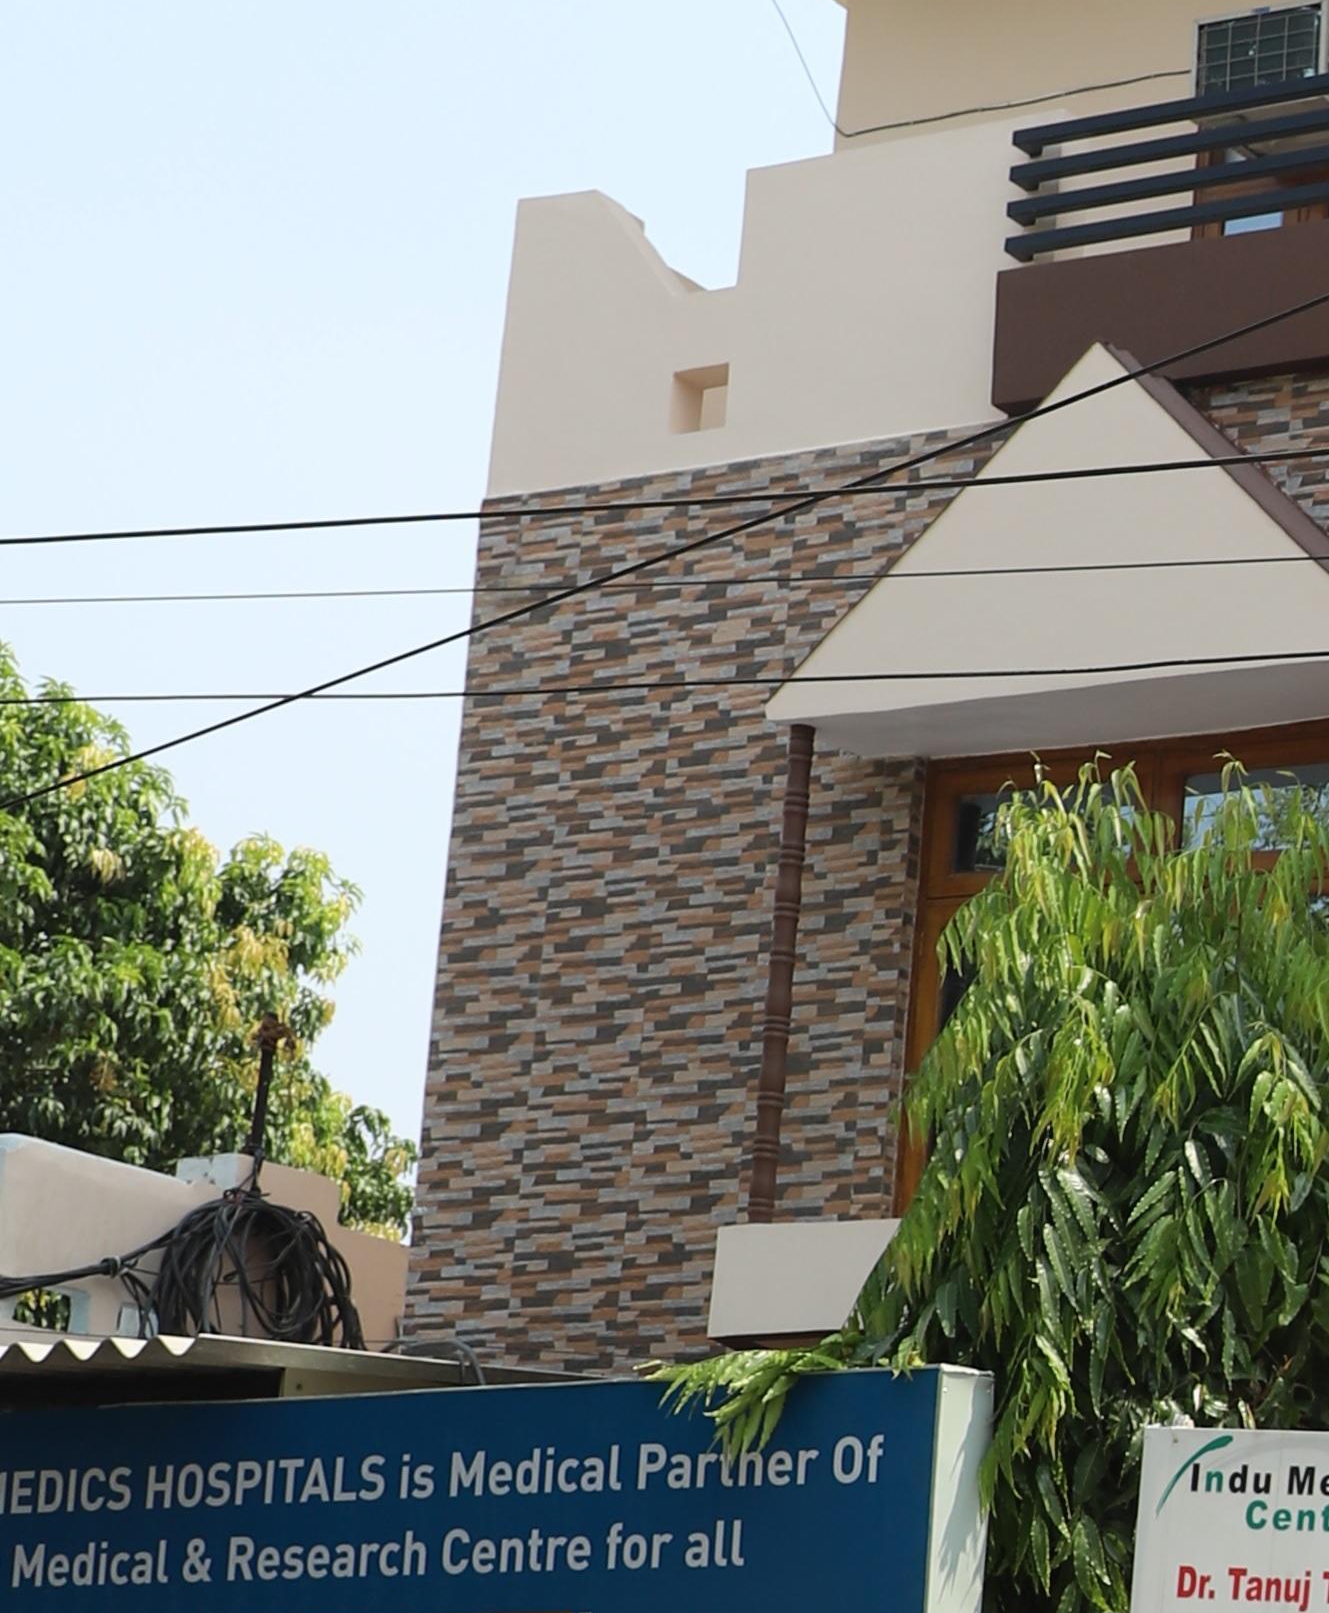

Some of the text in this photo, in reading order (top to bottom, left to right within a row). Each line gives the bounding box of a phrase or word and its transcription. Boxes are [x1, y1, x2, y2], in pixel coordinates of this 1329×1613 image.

[0, 1434, 885, 1514] EDICS HOSPITALS is Medical Partner Of
[1190, 1463, 1272, 1494] Indu
[12, 1519, 744, 1587] Medical & Research Centre for all
[1176, 1565, 1215, 1599] Dr.
[1228, 1567, 1311, 1612] Tanuj
